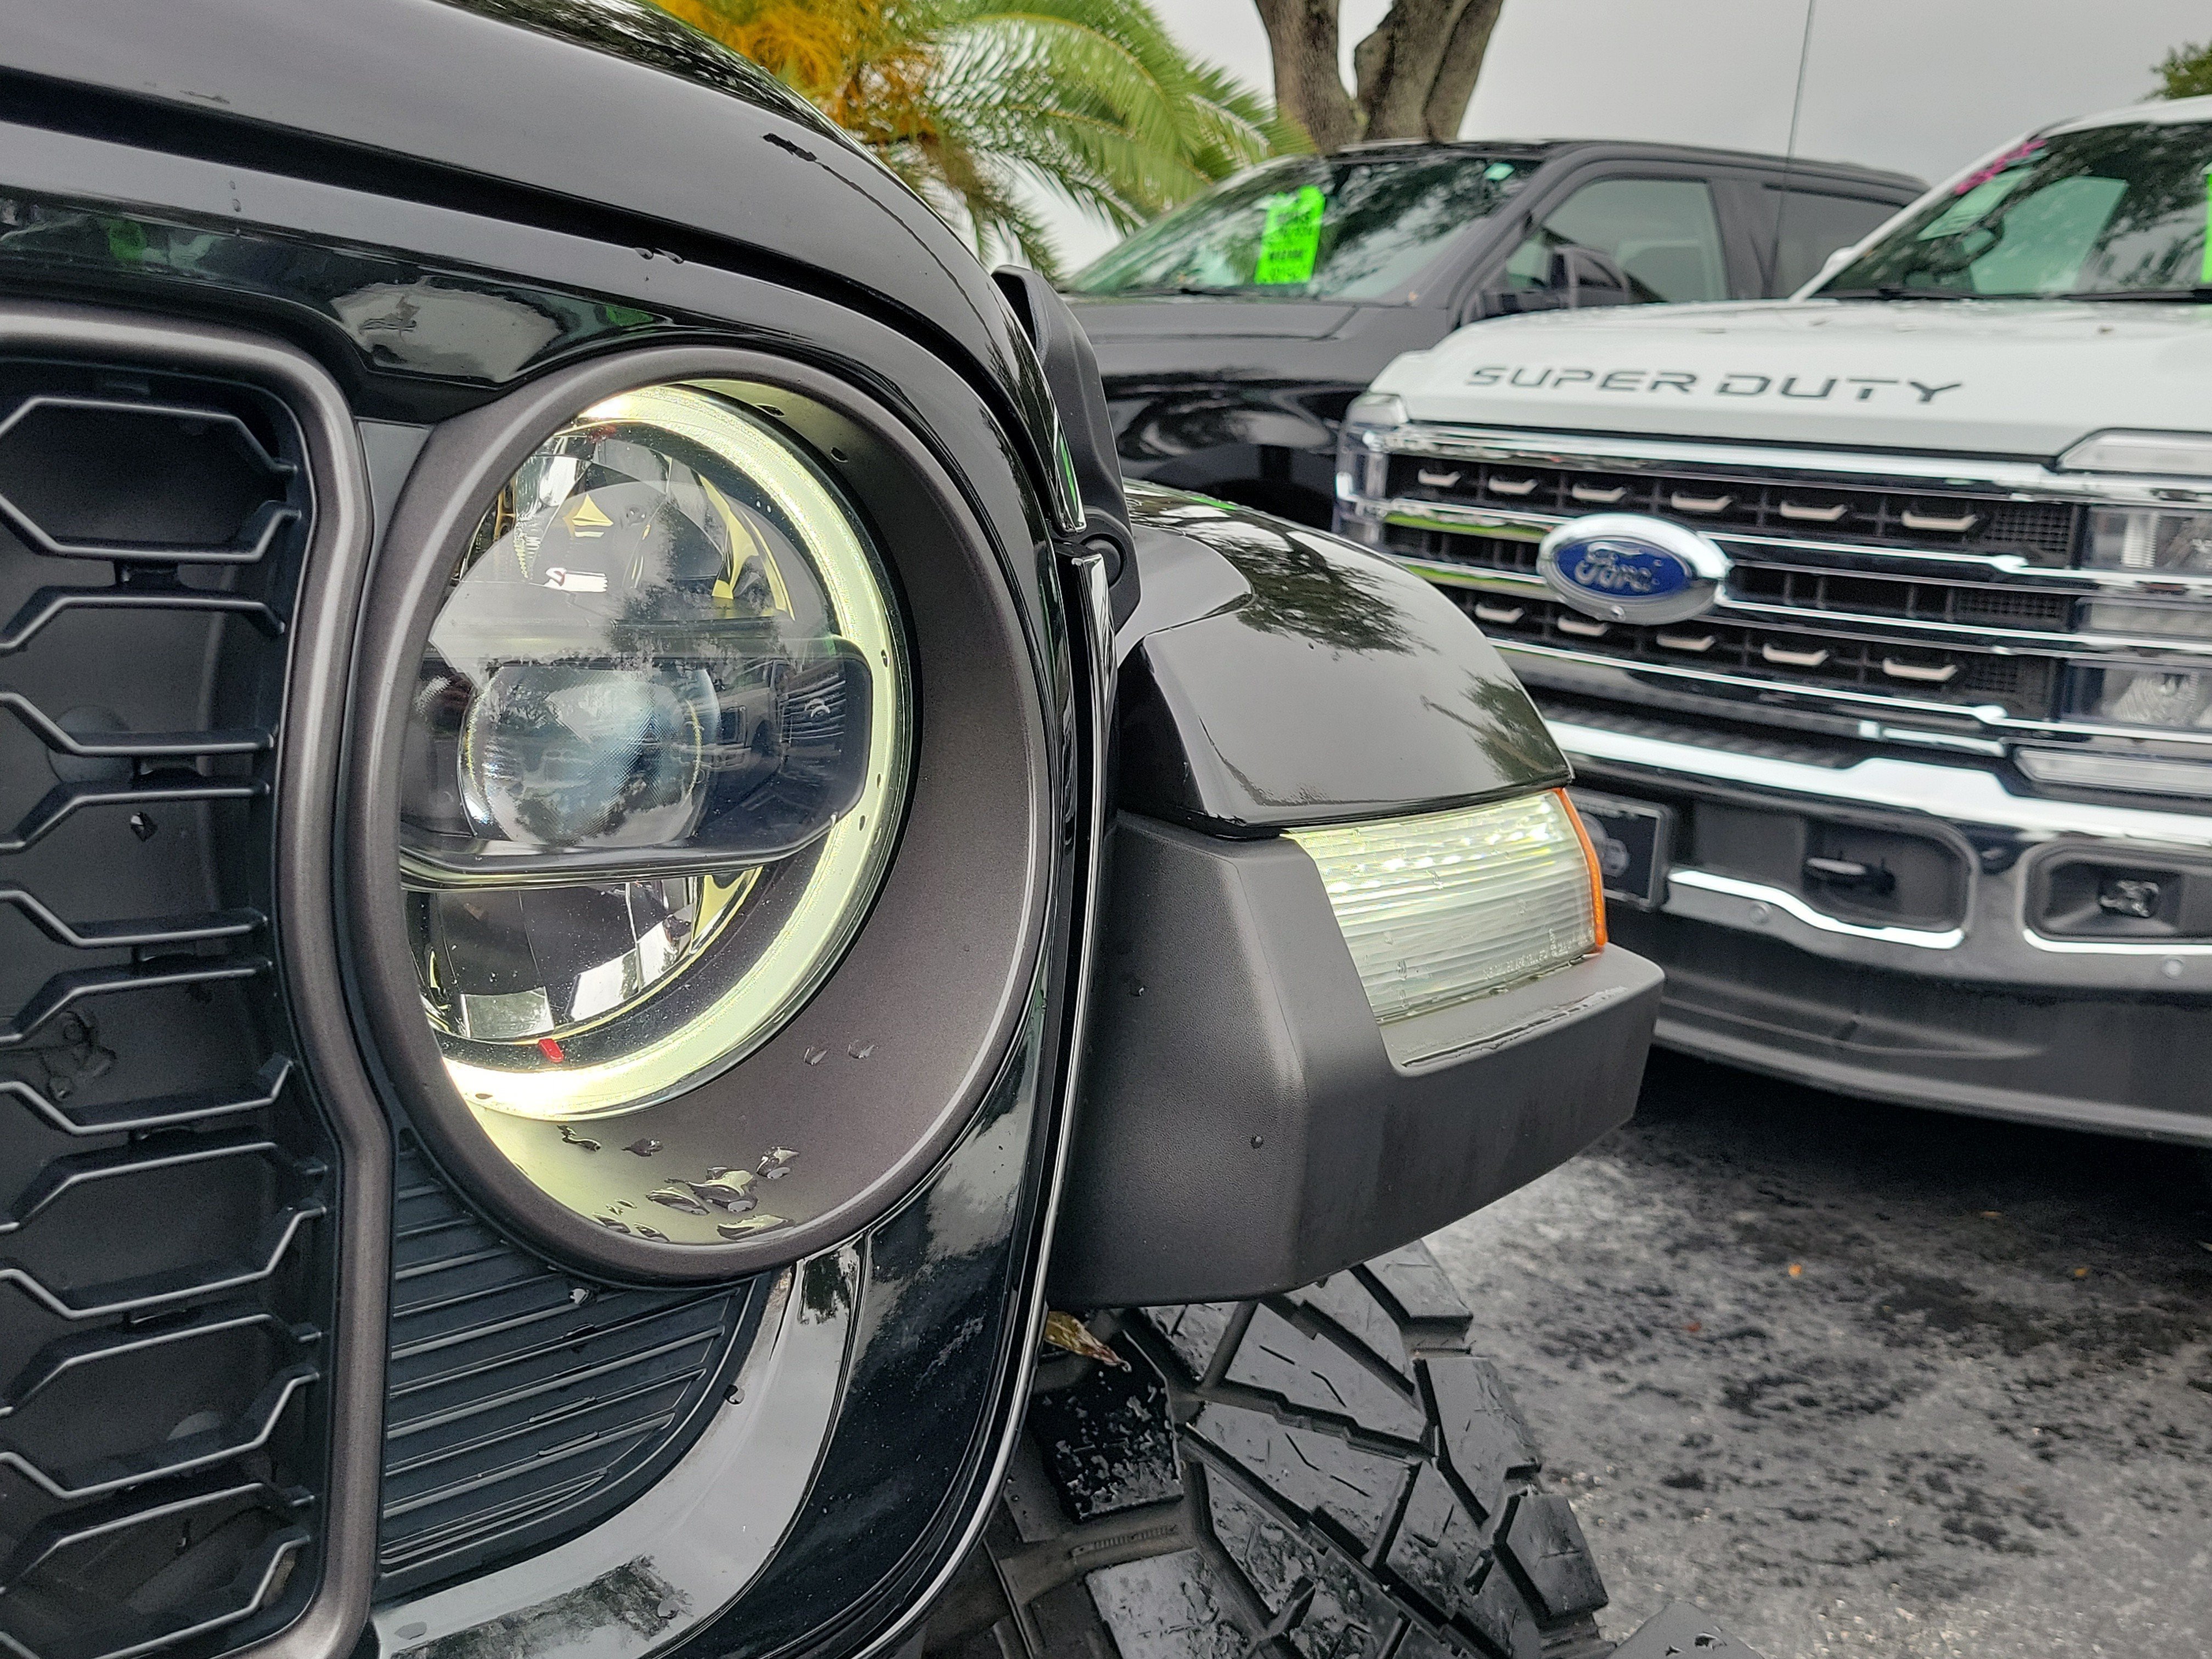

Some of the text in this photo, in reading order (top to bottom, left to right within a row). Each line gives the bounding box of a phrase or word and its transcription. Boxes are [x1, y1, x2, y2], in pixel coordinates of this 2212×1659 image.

[1468, 366, 1962, 403] SUPER DUTY
[1574, 541, 1664, 592] Ford
